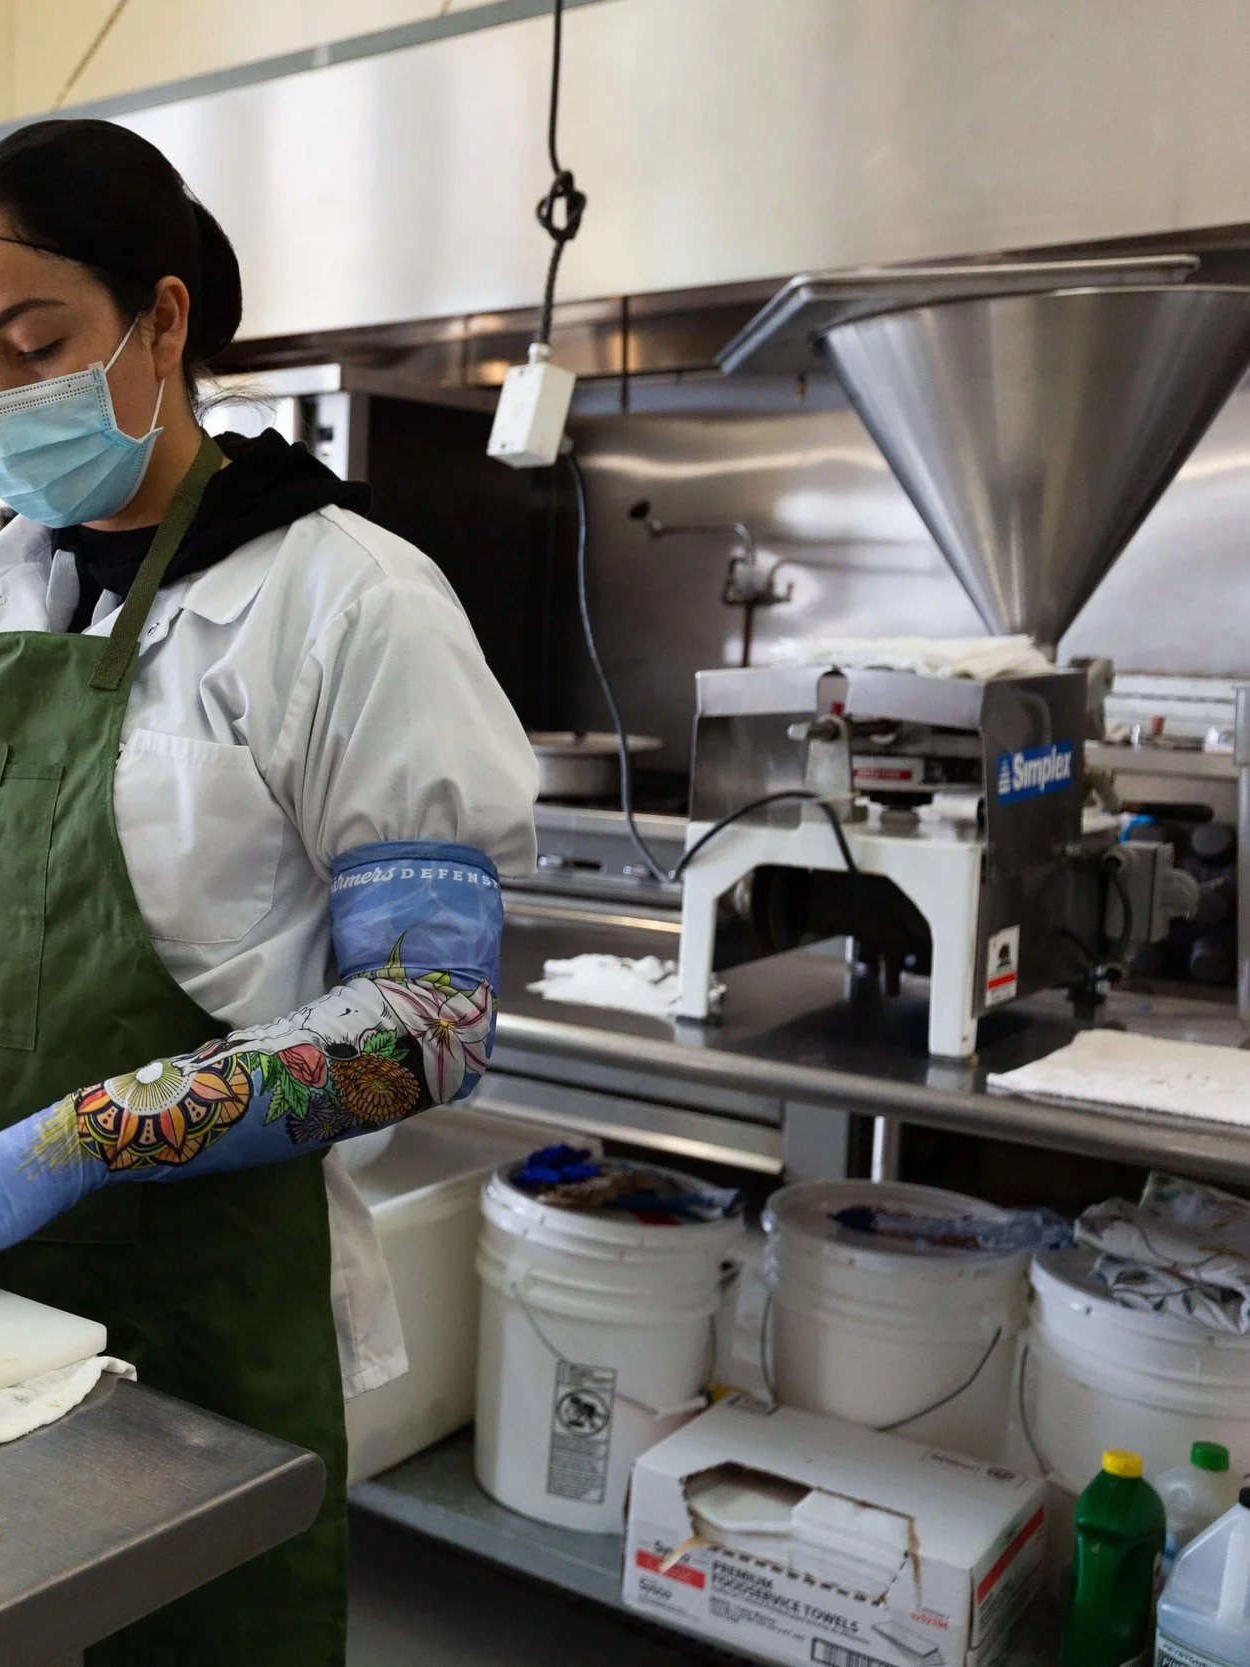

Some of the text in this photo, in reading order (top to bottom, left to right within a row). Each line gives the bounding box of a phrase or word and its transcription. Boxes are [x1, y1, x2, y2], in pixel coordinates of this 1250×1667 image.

[1012, 744, 1072, 792] Simplex
[330, 866, 396, 893] armers
[712, 1560, 774, 1589] PREMIUM
[711, 1571, 801, 1612] FOODSERVICE
[803, 1603, 860, 1634] TOWELS
